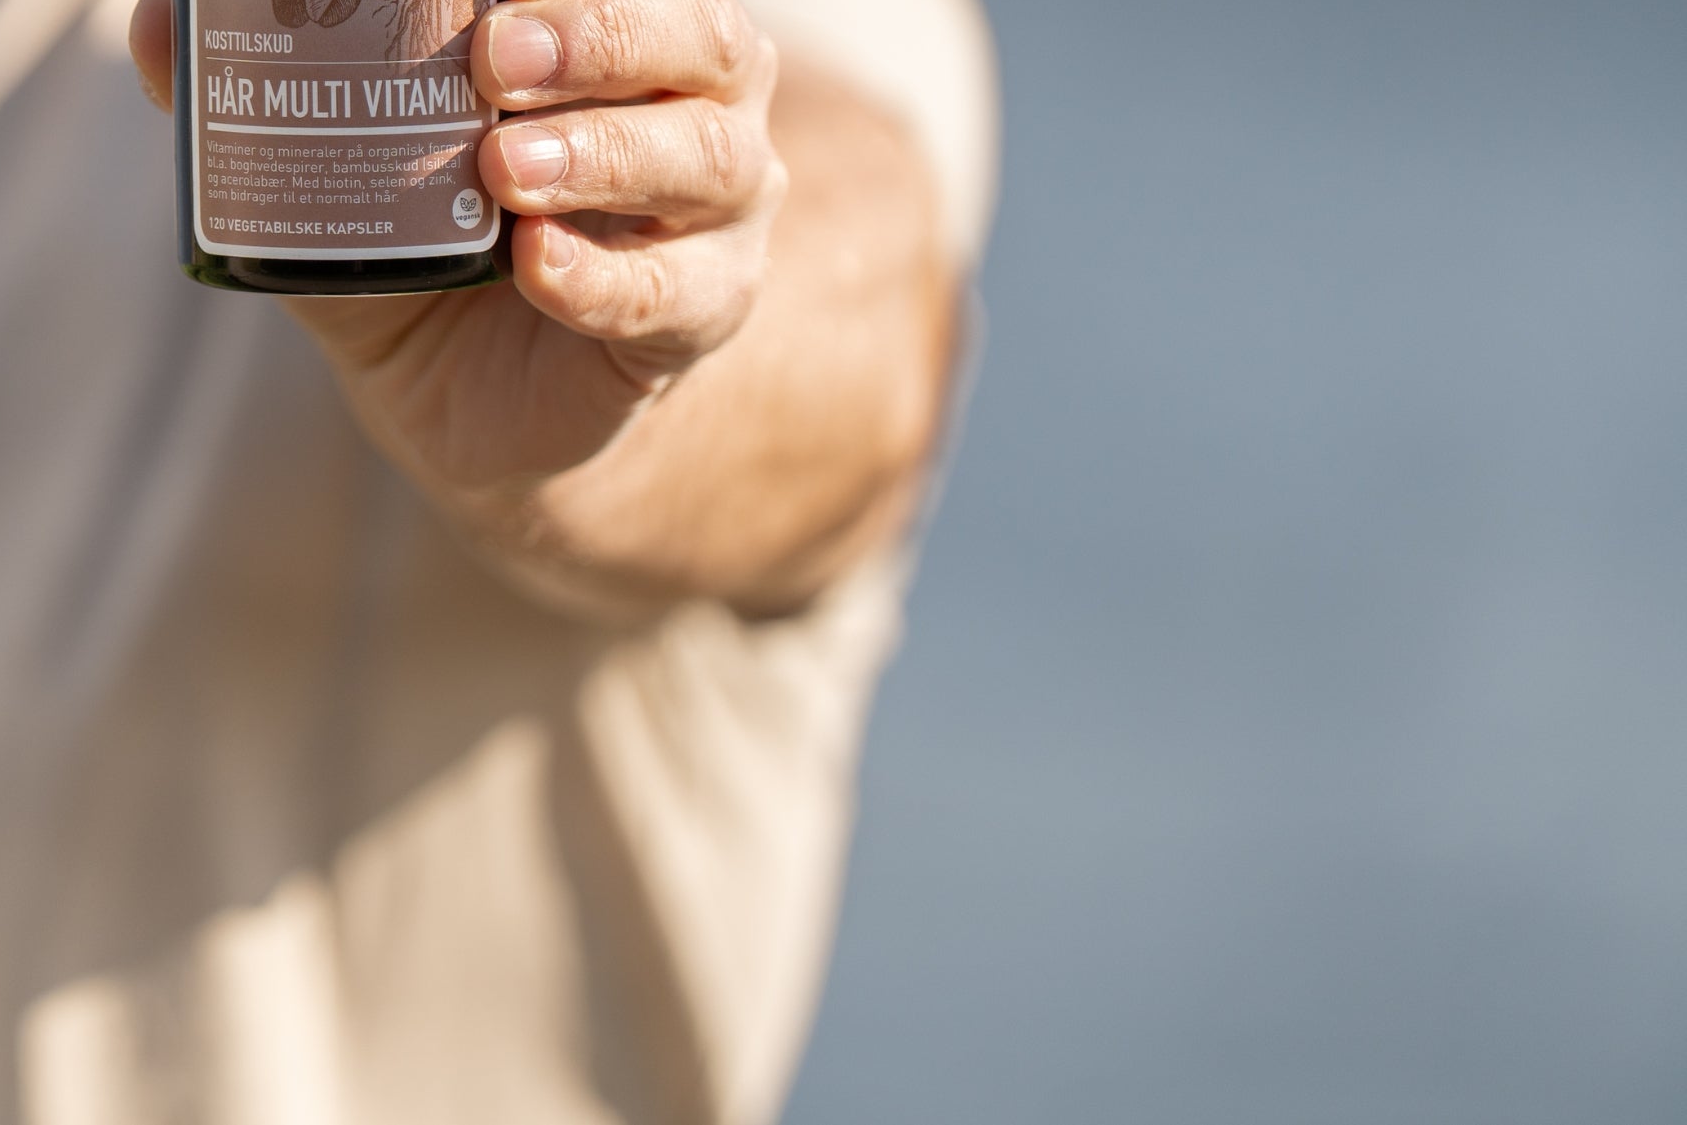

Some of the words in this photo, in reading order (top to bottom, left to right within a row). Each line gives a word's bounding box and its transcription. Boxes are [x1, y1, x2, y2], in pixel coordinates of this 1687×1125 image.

[205, 29, 293, 54] KOSTTILSKUD
[207, 66, 255, 116] HÅR
[264, 79, 351, 118] MULTI
[362, 74, 477, 118] VITAMIN
[207, 140, 256, 156] Vitaminer
[259, 147, 274, 160] og
[278, 145, 343, 158] mineraler
[348, 144, 363, 158] på
[368, 143, 425, 159] organisk
[429, 142, 457, 154] form
[208, 156, 227, 169] bl.a.
[230, 158, 328, 175] boghvedespirer,
[333, 160, 419, 174] bambusskud
[208, 174, 218, 187] og
[221, 175, 288, 188] acerolabær.
[292, 177, 320, 189] Med
[324, 177, 366, 190] biotin,
[370, 176, 406, 190] selen
[410, 176, 425, 190] og
[208, 189, 228, 200] som
[230, 189, 280, 206] bidrager
[283, 191, 296, 203] til
[299, 193, 312, 204] et
[316, 192, 371, 205] normalt
[375, 190, 400, 204] hår.
[209, 217, 225, 230] 120
[227, 219, 323, 235] VEGETABILSKE
[327, 221, 394, 236] KAPSLER
